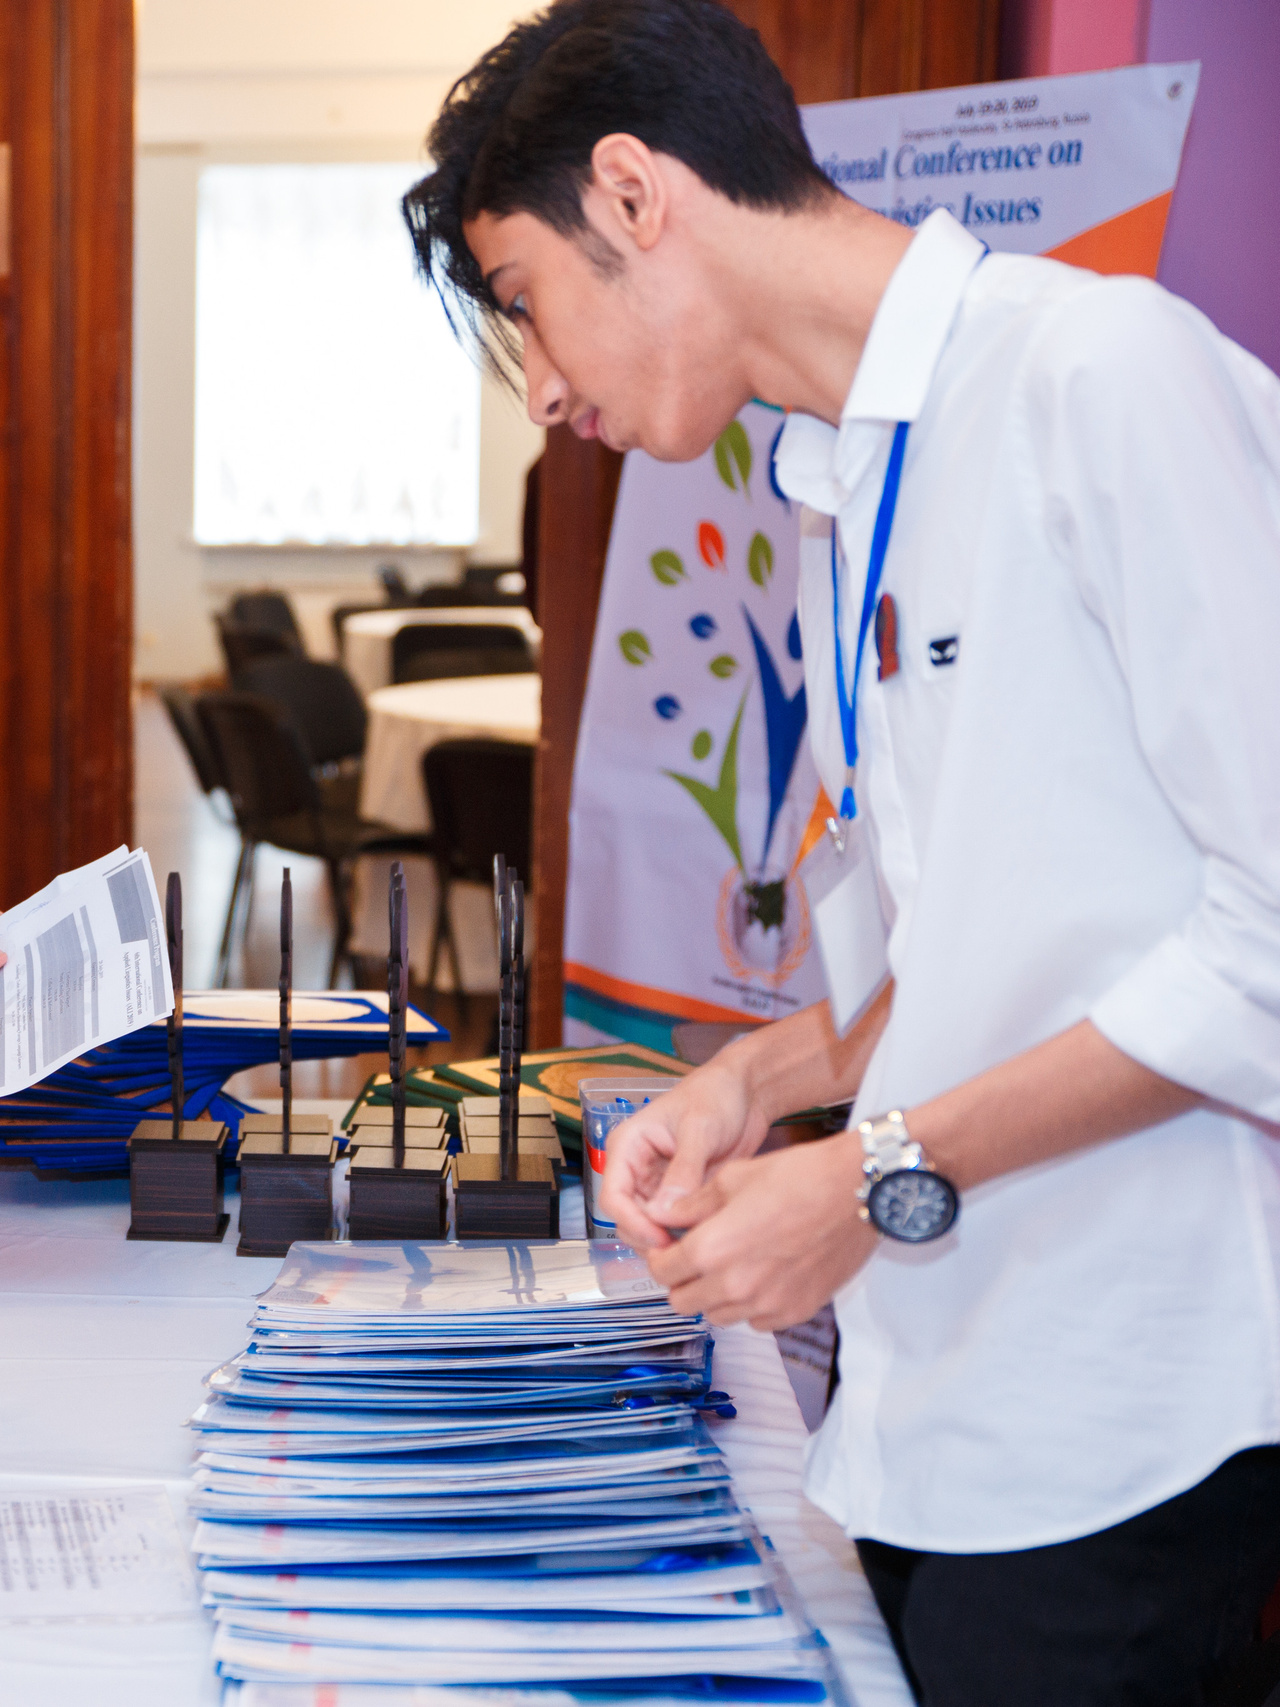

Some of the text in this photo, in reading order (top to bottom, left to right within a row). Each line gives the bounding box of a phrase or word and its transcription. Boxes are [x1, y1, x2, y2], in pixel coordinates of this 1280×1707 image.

[893, 140, 1043, 179] Conference
[1047, 138, 1083, 167] on
[962, 192, 1042, 228] Issues
